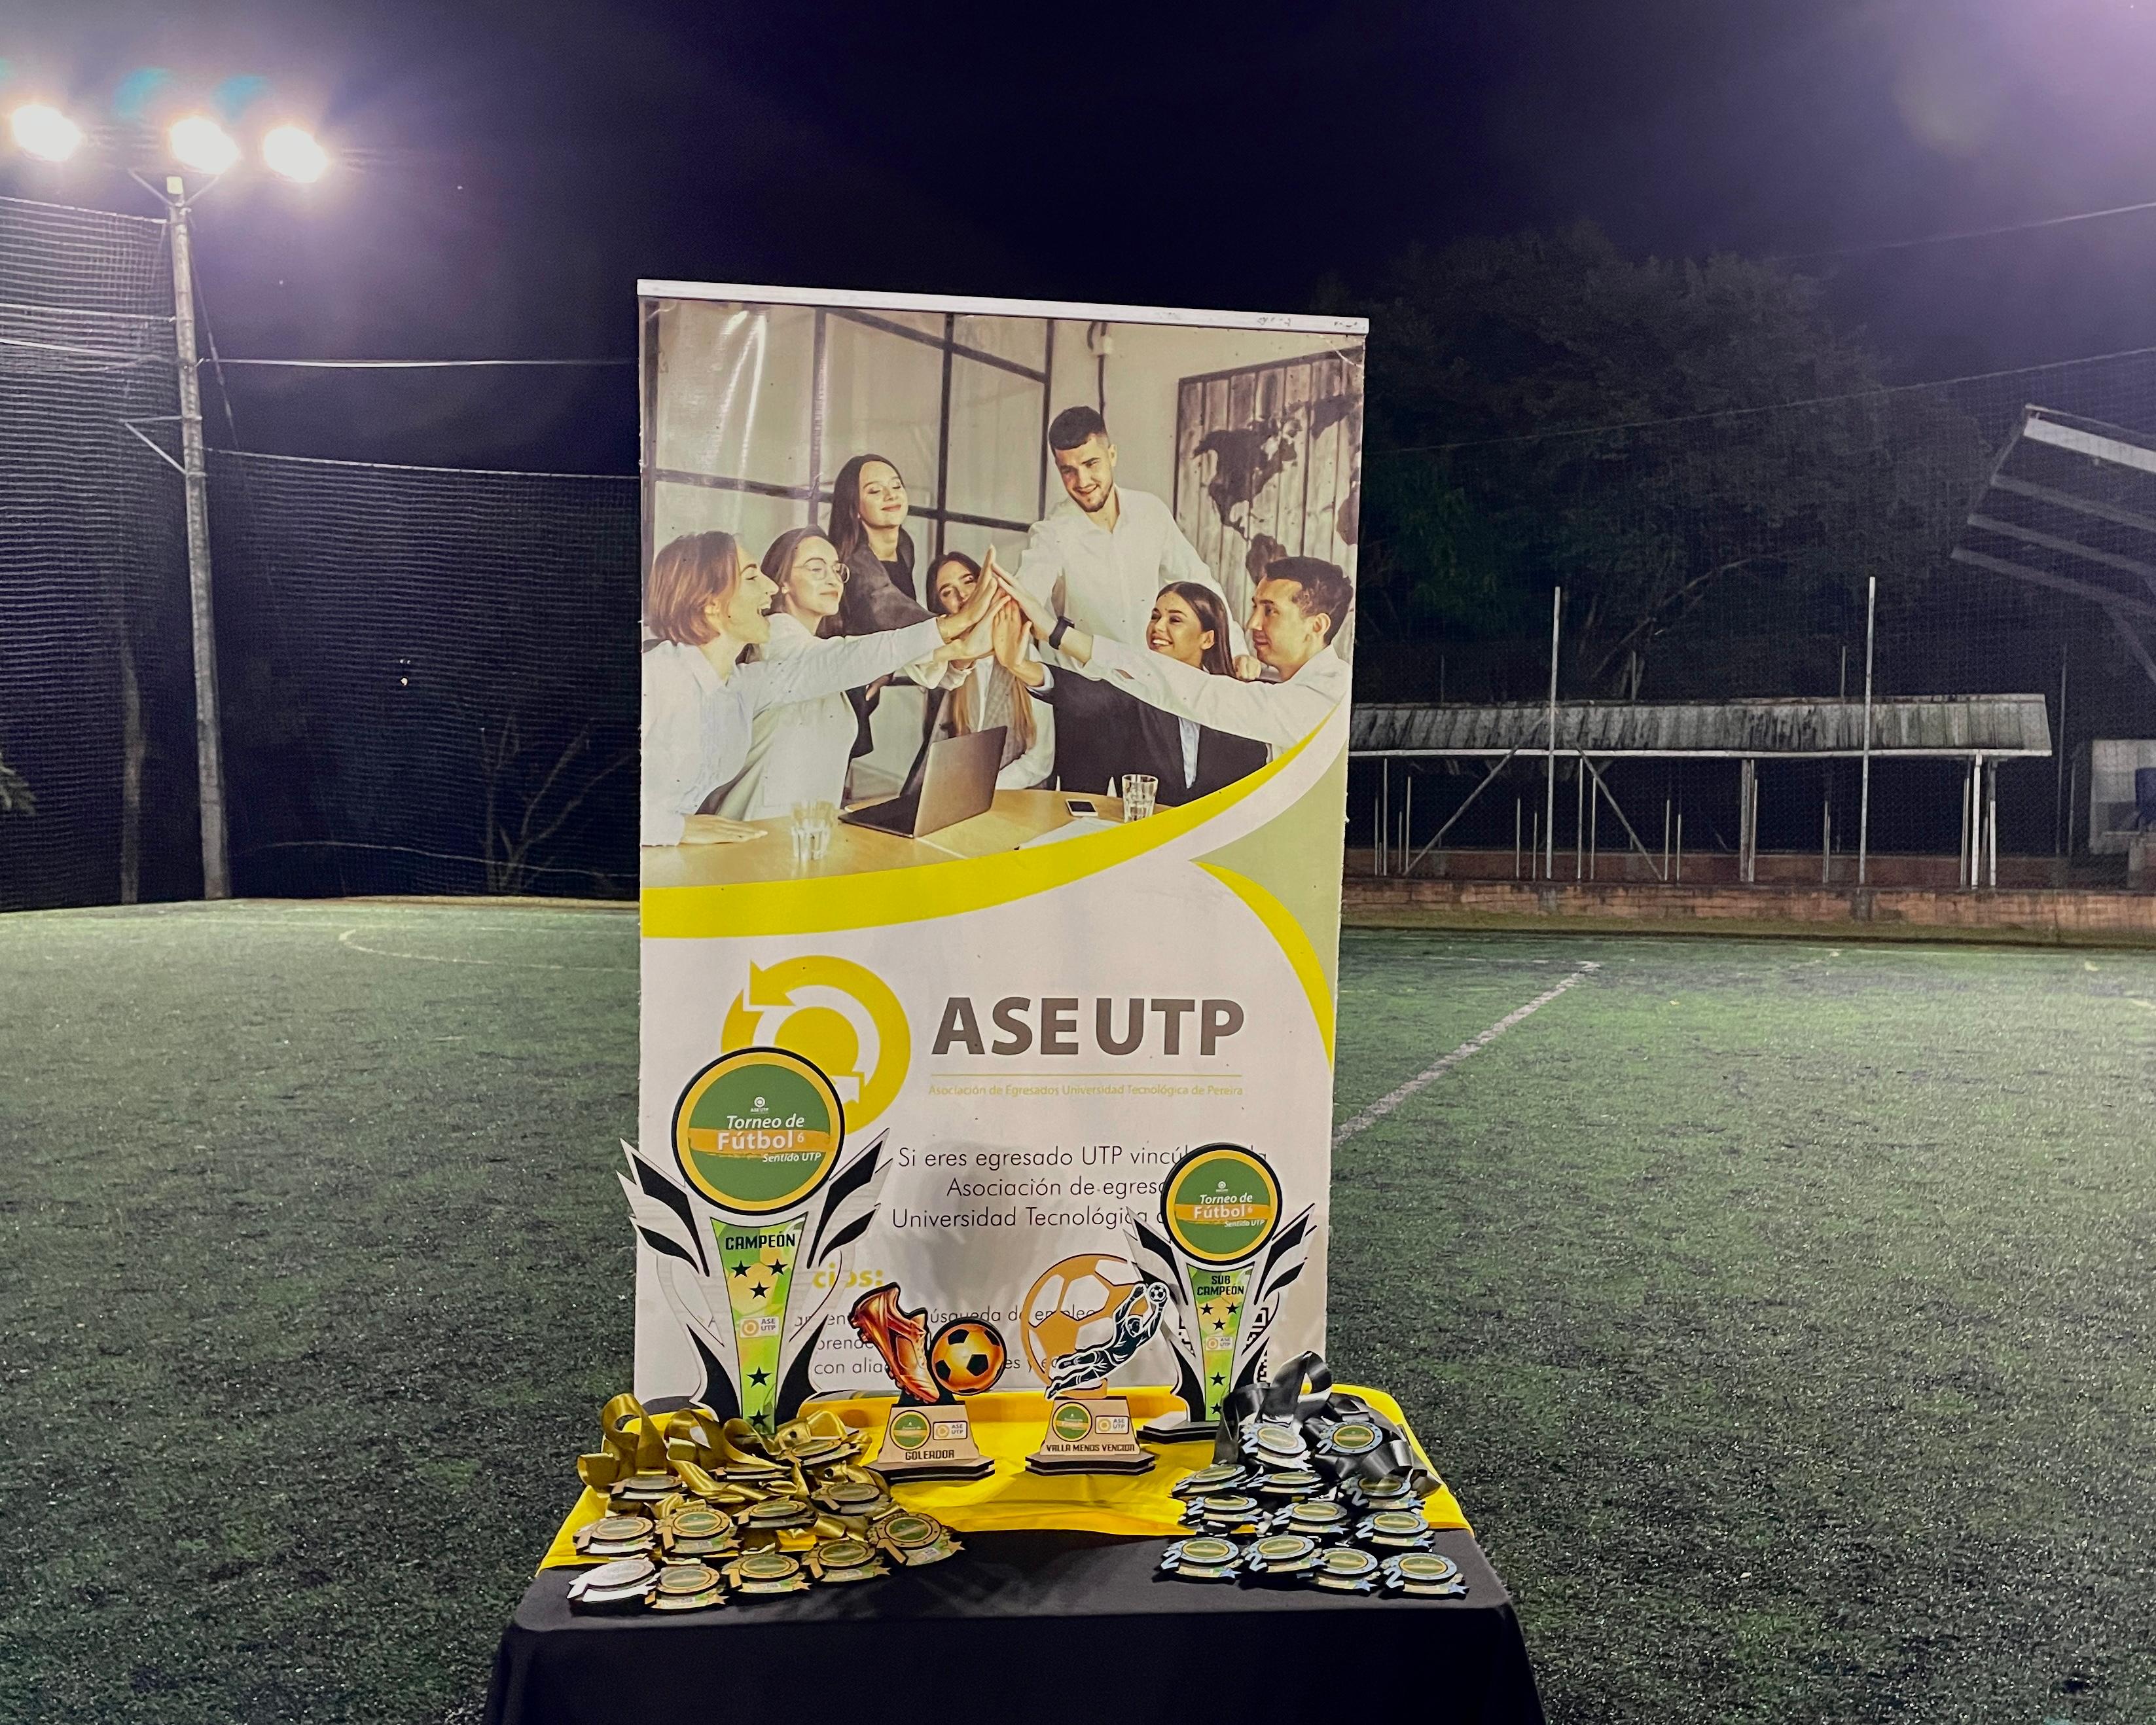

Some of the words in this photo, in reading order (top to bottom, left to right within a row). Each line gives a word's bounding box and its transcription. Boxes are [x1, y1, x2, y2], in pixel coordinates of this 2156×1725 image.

[929, 1085, 986, 1095] Asociación
[989, 1085, 1003, 1095] de
[1005, 1085, 1059, 1097] Egresados
[1063, 1085, 1124, 1095] Universidad
[1128, 1085, 1188, 1097] Tecnológica
[1191, 1085, 1204, 1095] de
[1208, 1085, 1243, 1095] Pereira
[727, 1116, 782, 1129] Torneo
[785, 1114, 805, 1127] de
[718, 1130, 793, 1151] Fútbol
[762, 1152, 800, 1163] Sentido
[802, 1152, 821, 1161] UTP
[898, 1148, 916, 1167] Si
[925, 1153, 967, 1167] eres
[976, 1146, 1073, 1171] egresado
[1083, 1146, 1123, 1165] UTP
[946, 1178, 1061, 1197] Asociación
[1070, 1176, 1095, 1195] de
[1200, 1194, 1237, 1205] Torneo
[1240, 1192, 1253, 1203] de
[893, 1207, 1016, 1228] Universidad
[1194, 1204, 1245, 1219] Fútbol
[725, 1231, 796, 1250] CAMPEÓN
[1212, 1275, 1231, 1284] SUB
[814, 1364, 845, 1375] con
[852, 1357, 884, 1374] alia
[1242, 1434, 1258, 1454] 2
[905, 1449, 954, 1461] GOLEADOR
[1187, 1500, 1204, 1516] 2
[1272, 1510, 1293, 1525] 2
[1356, 1521, 1374, 1538] 2
[1161, 1550, 1181, 1570] 2
[1244, 1552, 1268, 1571] 2
[1383, 1567, 1405, 1588] 2
